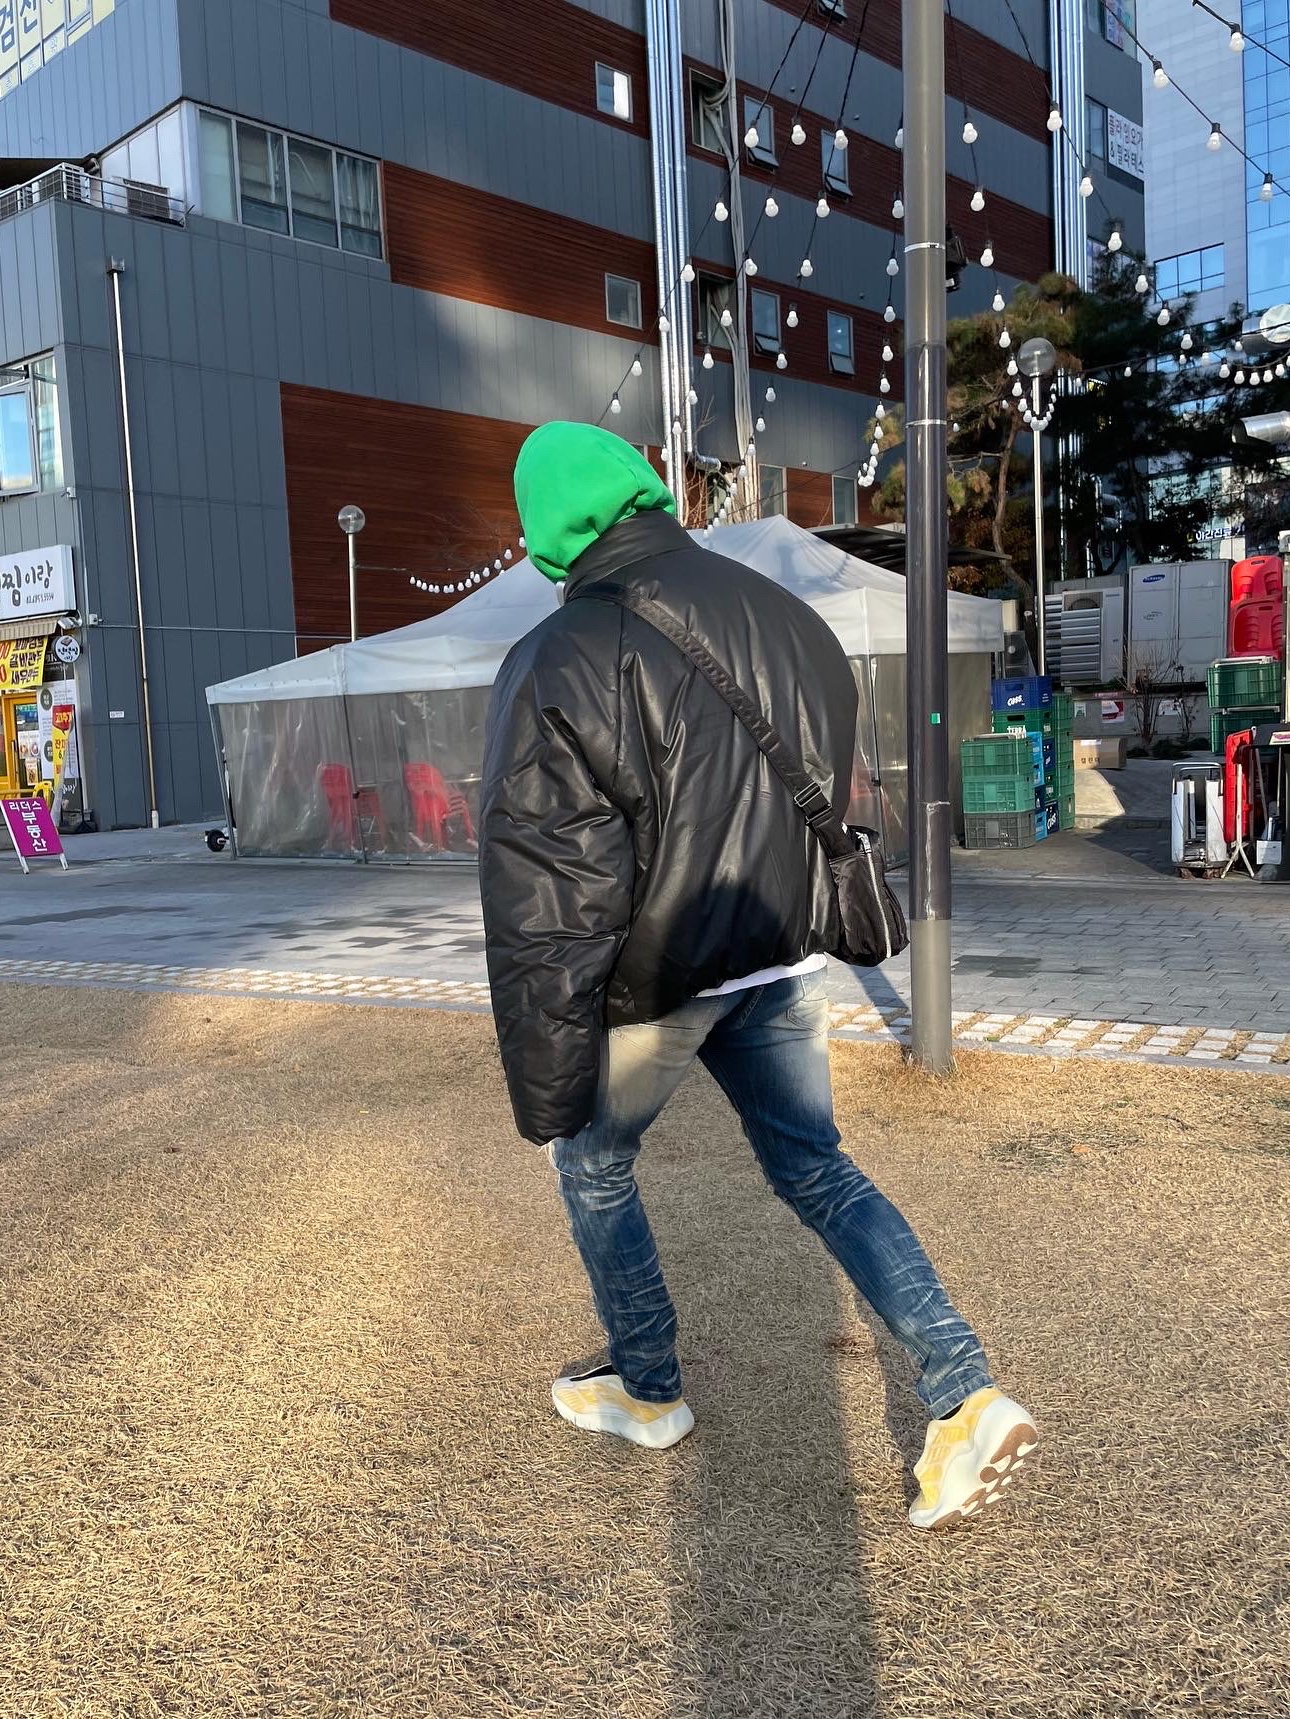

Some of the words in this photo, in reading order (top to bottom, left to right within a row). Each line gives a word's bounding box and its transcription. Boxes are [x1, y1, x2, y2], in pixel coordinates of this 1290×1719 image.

[0, 560, 53, 607] 찜이랑
[9, 801, 43, 811] 리더스
[21, 812, 48, 852] 부동산
